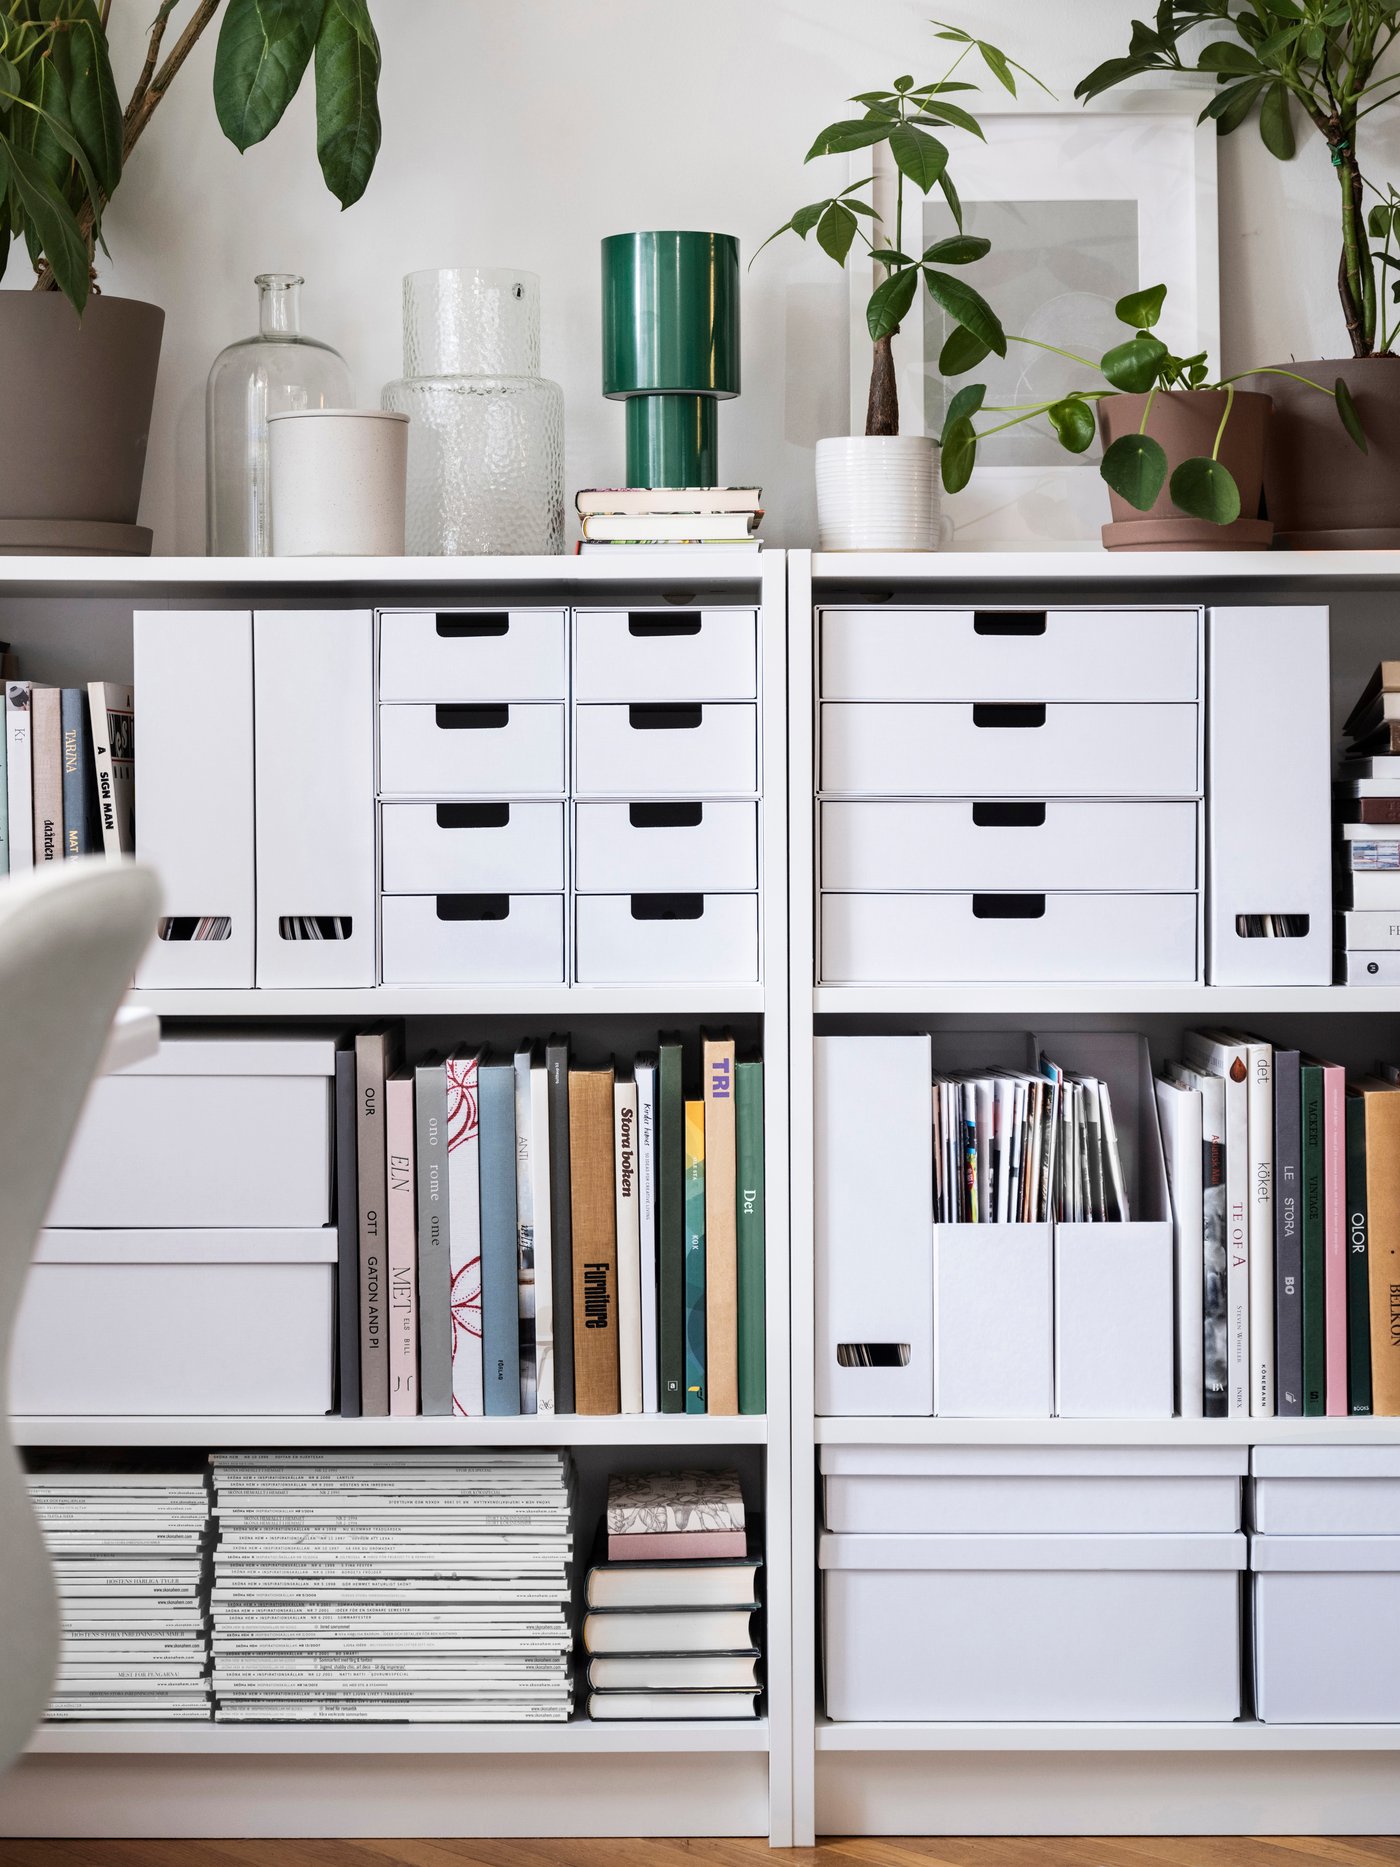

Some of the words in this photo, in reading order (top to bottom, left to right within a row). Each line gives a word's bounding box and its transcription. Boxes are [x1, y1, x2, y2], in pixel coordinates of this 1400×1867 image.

[98, 746, 106, 755] A
[100, 772, 111, 799] SIGN
[104, 802, 114, 830] MAN
[69, 830, 79, 853] MAT
[712, 1058, 730, 1098] TRI
[1257, 1059, 1270, 1084] det
[365, 1087, 375, 1116] OUR
[429, 1118, 438, 1146] ono
[621, 1107, 633, 1149] Stora
[1309, 1100, 1318, 1147] VACKERT
[430, 1164, 439, 1201] rome
[621, 1150, 634, 1197] boken
[1257, 1162, 1270, 1203] köket
[1284, 1166, 1294, 1180] LE
[744, 1190, 756, 1214] Det
[1309, 1176, 1318, 1219] VINTAGE
[367, 1211, 378, 1236] OTT
[1233, 1202, 1242, 1222] TE
[1284, 1198, 1294, 1237] STORA
[431, 1216, 439, 1246] ome
[1233, 1229, 1243, 1249] OF
[1352, 1213, 1364, 1254] OLOR
[1233, 1256, 1246, 1267] A
[368, 1256, 378, 1302] GATON
[393, 1267, 412, 1314] MET
[1285, 1276, 1295, 1295] BO
[584, 1263, 609, 1328] Furniture
[369, 1306, 379, 1334] AND
[369, 1338, 379, 1348] PI
